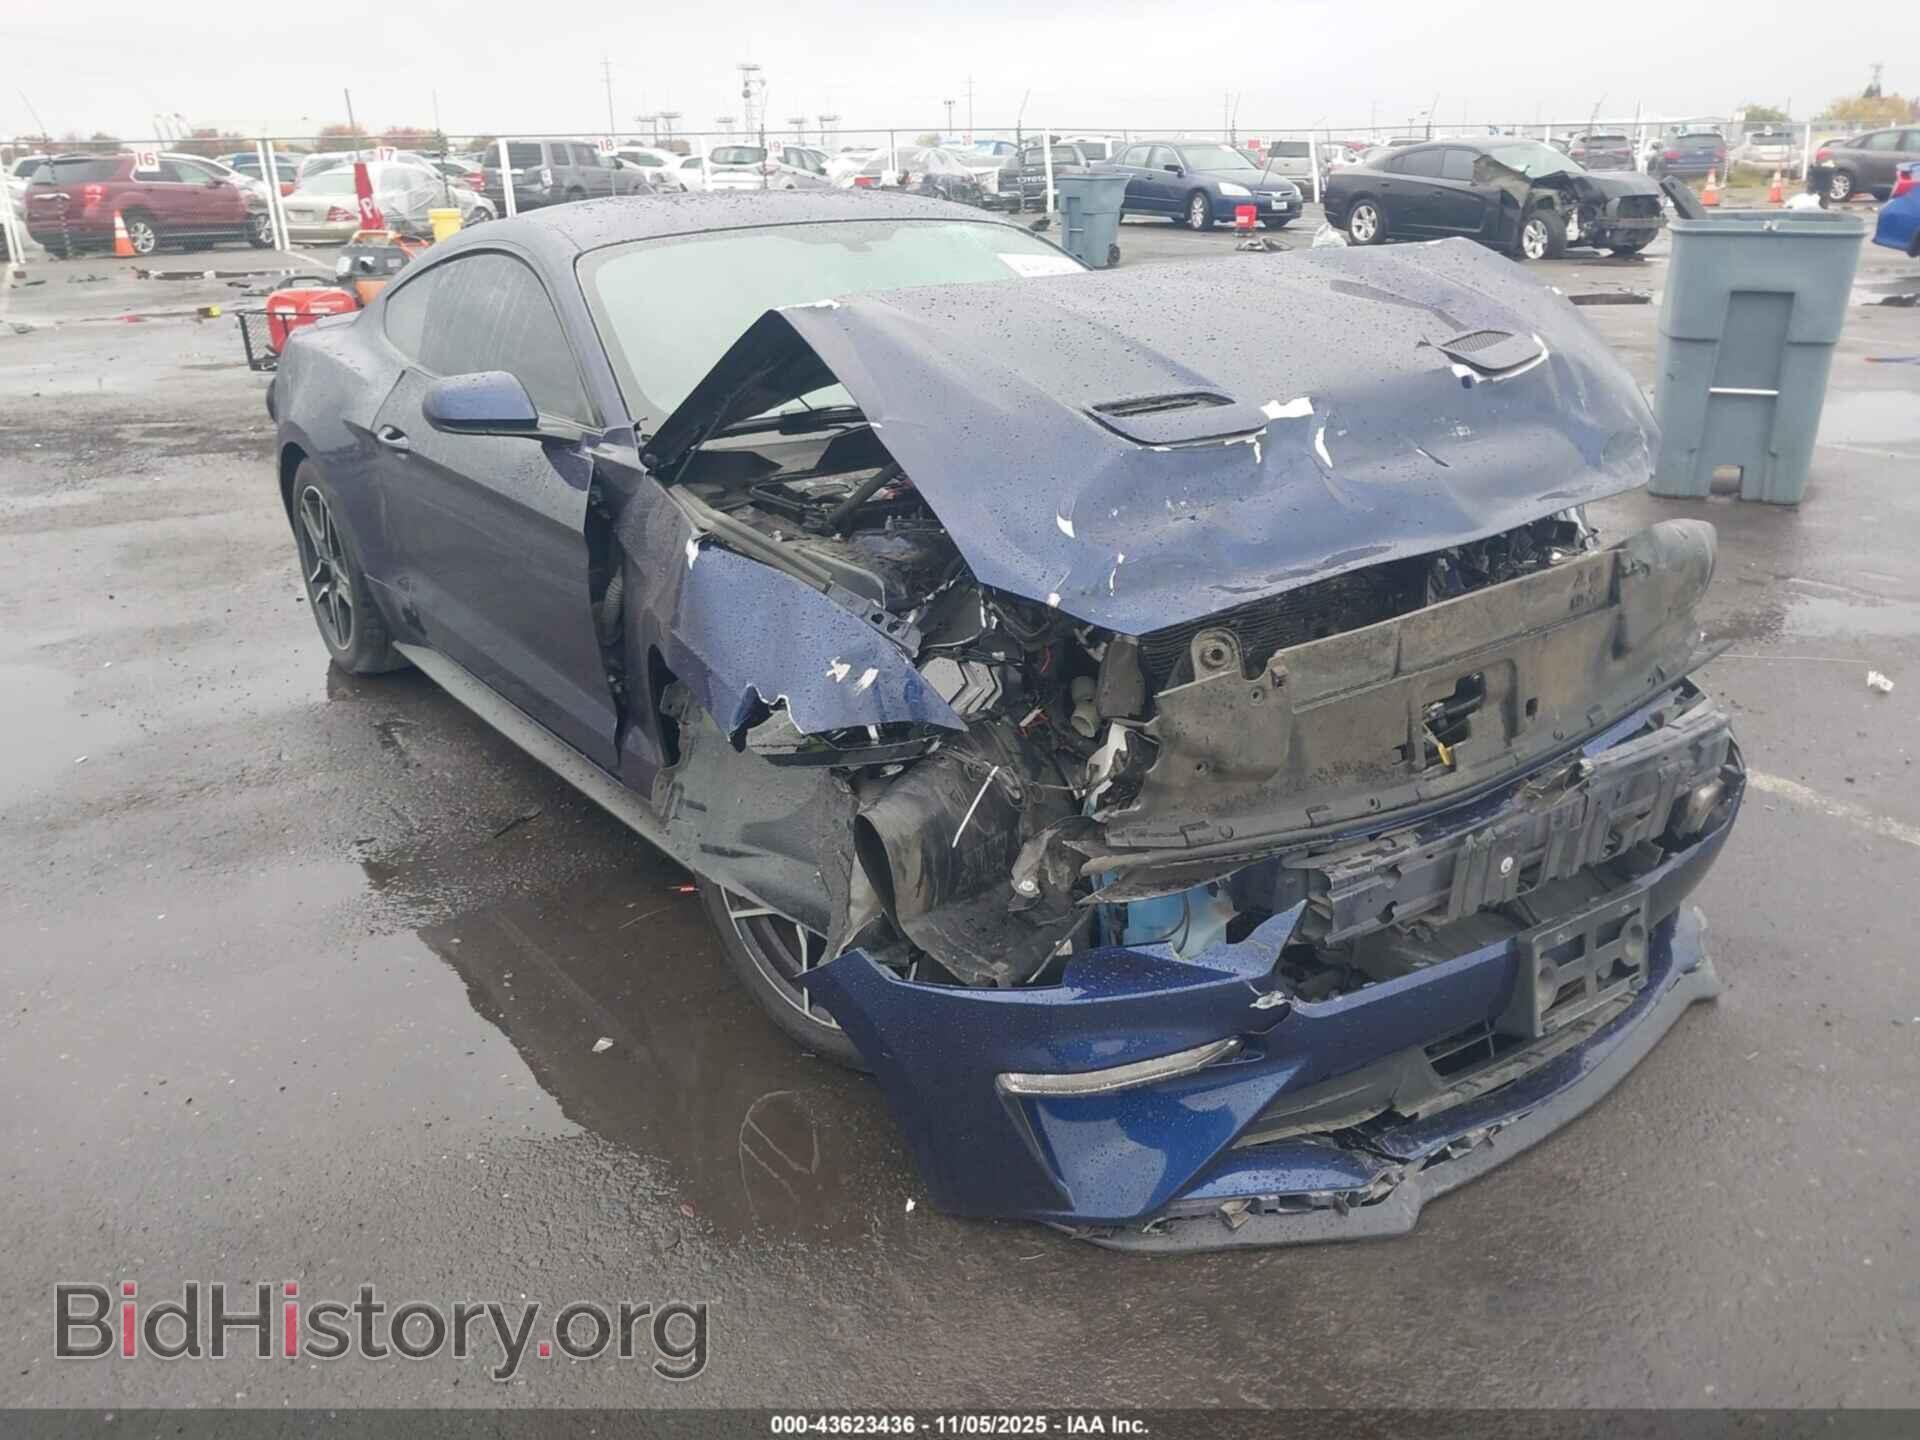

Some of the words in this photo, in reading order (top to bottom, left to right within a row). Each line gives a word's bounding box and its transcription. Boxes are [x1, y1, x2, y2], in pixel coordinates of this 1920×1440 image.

[599, 138, 615, 153] 18
[768, 139, 781, 153] 19
[137, 151, 156, 167] 16
[379, 147, 395, 161] 17
